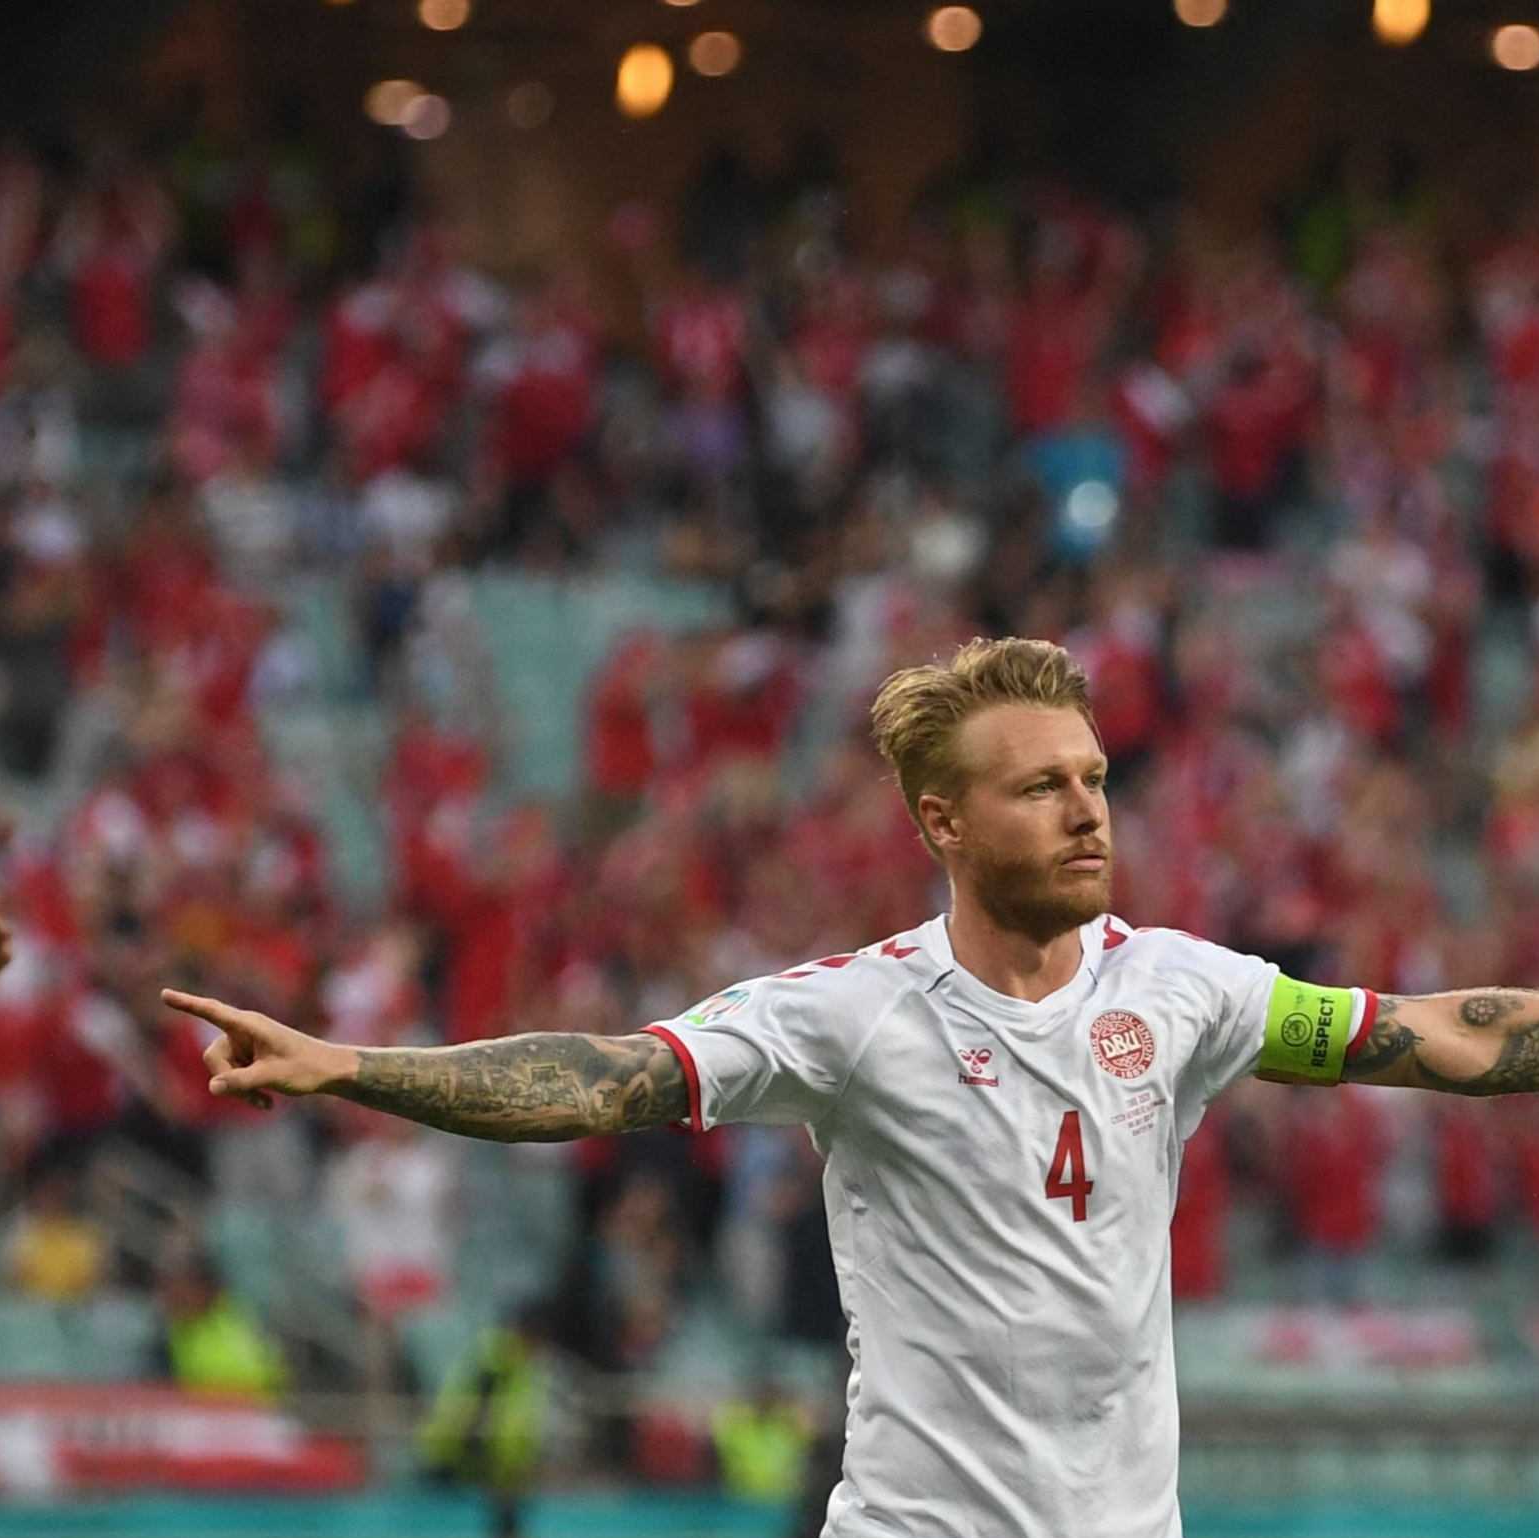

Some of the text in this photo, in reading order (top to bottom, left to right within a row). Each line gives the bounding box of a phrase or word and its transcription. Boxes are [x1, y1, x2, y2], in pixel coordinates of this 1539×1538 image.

[1099, 1030, 1142, 1059] DBU
[1311, 997, 1335, 1068] RESPECT
[1044, 1110, 1094, 1222] 4
